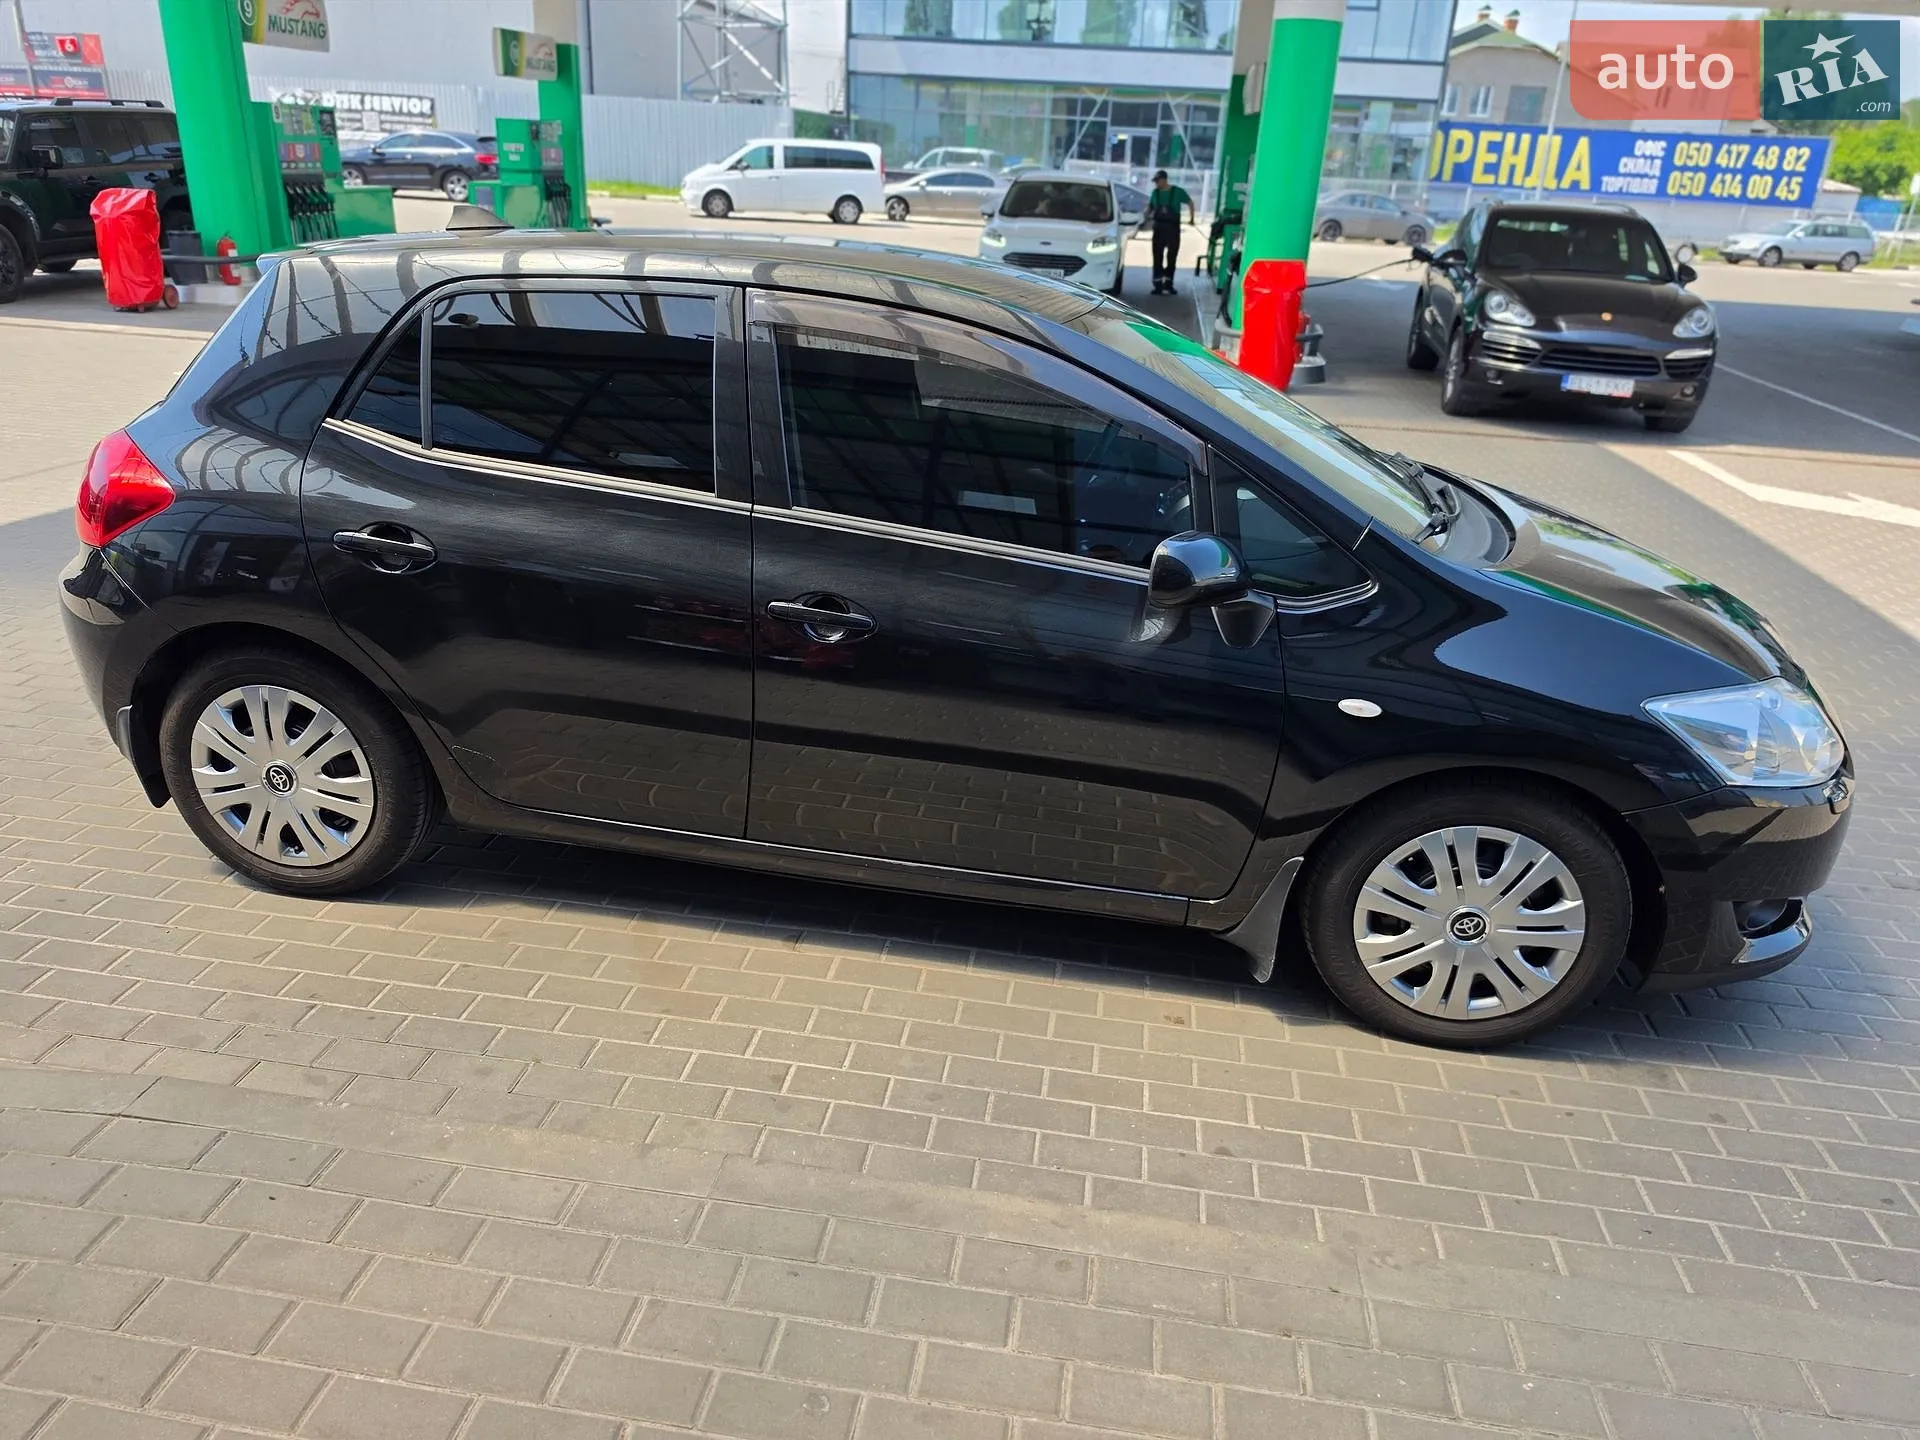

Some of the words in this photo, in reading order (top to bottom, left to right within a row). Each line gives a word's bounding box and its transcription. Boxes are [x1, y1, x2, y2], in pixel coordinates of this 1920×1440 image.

[243, 0, 253, 18] 9
[268, 15, 327, 39] MUSTANG
[1673, 141, 1713, 167] 050
[1715, 143, 1750, 169] 417
[1752, 145, 1780, 171] 48
[1782, 146, 1811, 172] 82
[1666, 171, 1707, 197] 050
[1709, 172, 1743, 198] 414
[1746, 174, 1773, 200] 00
[1774, 176, 1803, 201] 45
